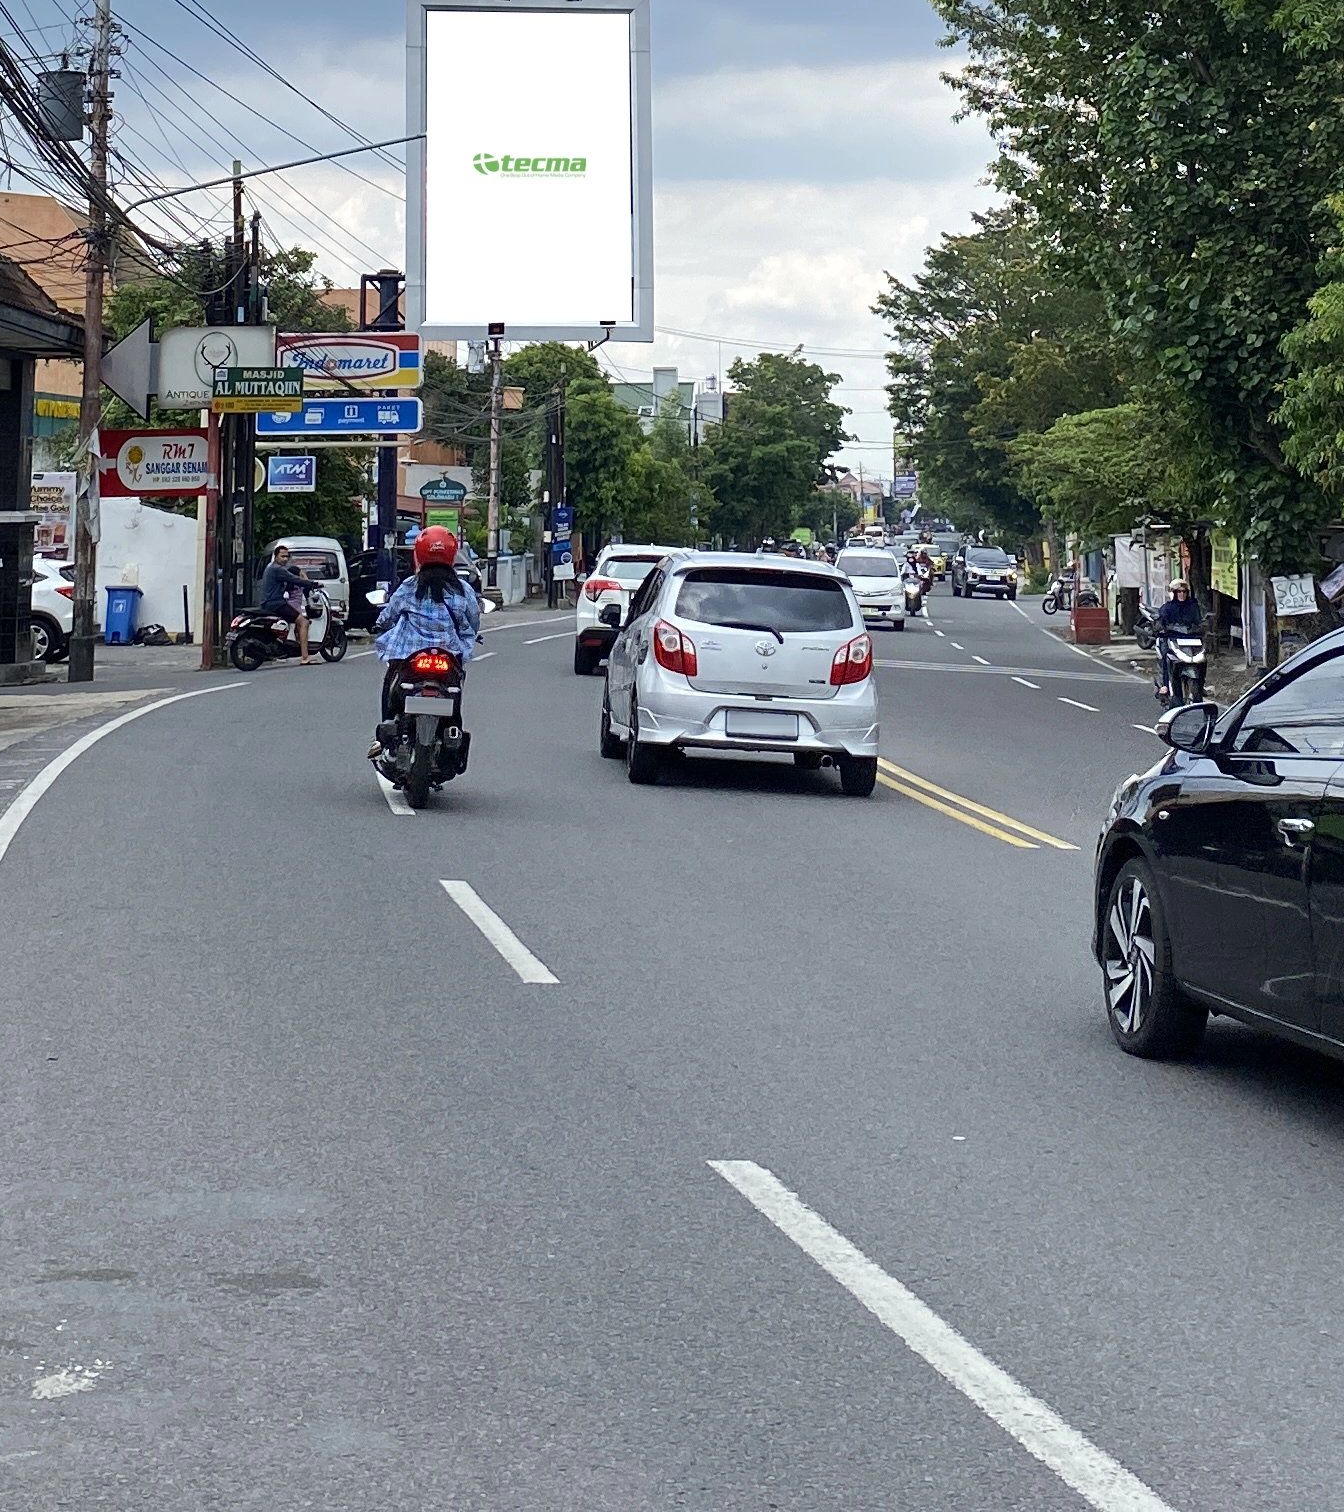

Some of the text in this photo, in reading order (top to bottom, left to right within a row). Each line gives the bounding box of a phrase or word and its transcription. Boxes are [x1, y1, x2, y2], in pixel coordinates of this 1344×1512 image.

[500, 155, 587, 172] tecma
[292, 351, 390, 371] Indomaret
[243, 370, 285, 379] MASJID
[216, 381, 301, 396] AL MUTTAQIIN
[146, 462, 181, 474] SANGGAR
[51, 504, 70, 513] Gold
